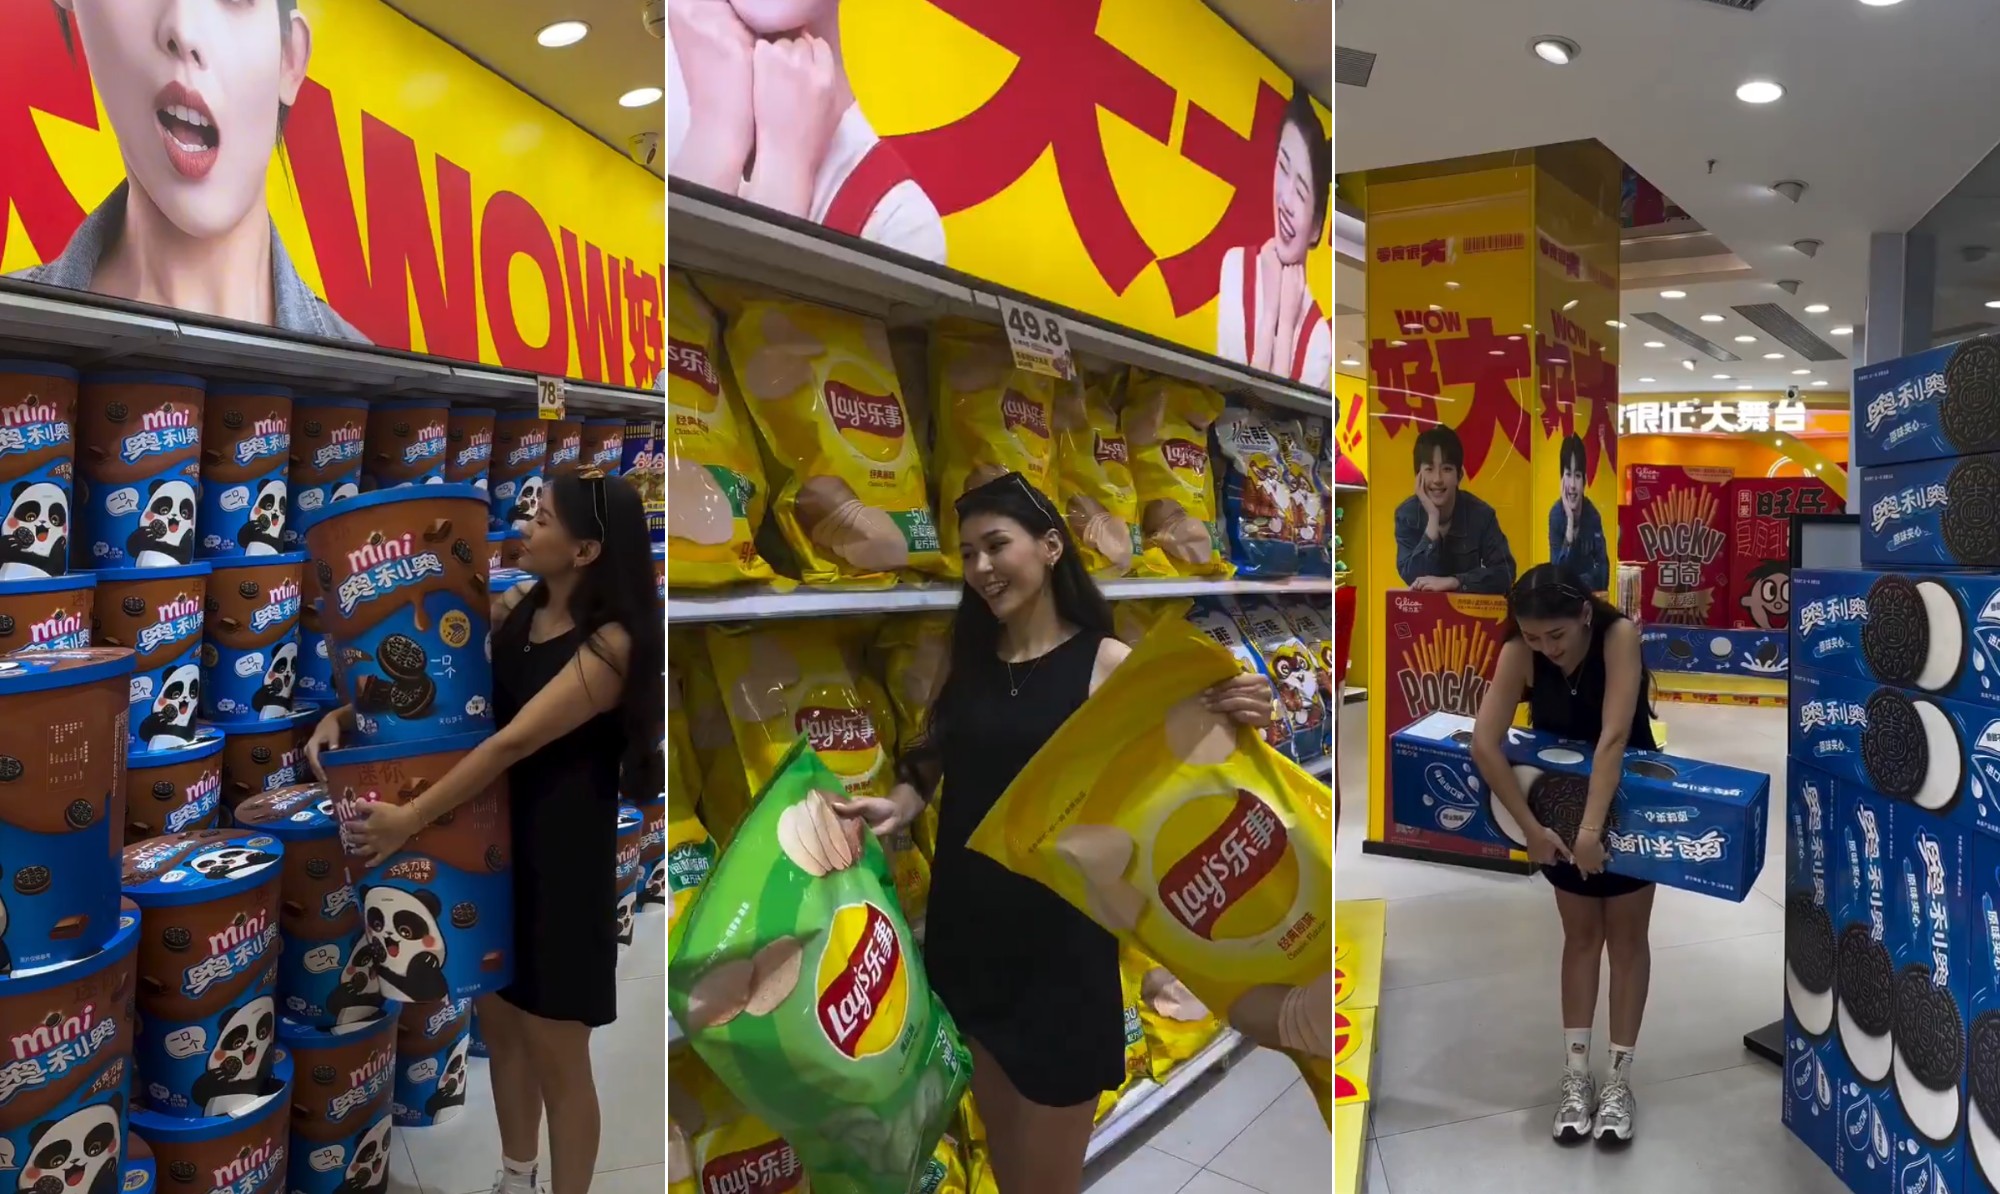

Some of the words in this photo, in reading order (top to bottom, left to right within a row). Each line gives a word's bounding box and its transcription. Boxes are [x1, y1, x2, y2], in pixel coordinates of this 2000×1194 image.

[283, 76, 627, 386] WOW
[623, 255, 664, 389] 好
[1008, 307, 1063, 347] 49.8
[1394, 309, 1462, 336] WOW
[1551, 309, 1587, 349] WOW
[539, 381, 556, 405] 78
[830, 390, 868, 427] Lay's
[868, 403, 902, 428] 乐事
[1369, 317, 1532, 482] 好大
[1866, 372, 1949, 433] 奥利奥
[2, 402, 57, 426] mini
[142, 408, 189, 430] mini
[1888, 420, 1921, 444] 原味夹心
[1756, 488, 1828, 520] 旺仔
[1871, 484, 1949, 533] 奥利奥
[348, 532, 412, 572] mini
[1893, 526, 1923, 547] 原味夹心
[339, 552, 443, 612] 奥利奥
[1658, 561, 1700, 587] 百奇
[31, 612, 82, 643] mini
[158, 596, 200, 623] mini
[1799, 597, 1869, 636] 奥利奥
[430, 655, 452, 665] 一口
[1819, 637, 1846, 653] 原味夹心
[433, 666, 456, 679] 一个
[1799, 699, 1869, 734] 奥利奥
[1819, 739, 1846, 754] 原味夹心
[1645, 810, 1690, 823] 原味夹心
[1608, 830, 1726, 862] 奥利奥
[1802, 780, 1825, 907] 奥利奥
[390, 860, 432, 876] 巧克力味
[1168, 852, 1231, 927] Lay's
[1219, 802, 1276, 877] 乐事
[1857, 803, 1885, 942] 奥利奥
[1907, 873, 1921, 928] 原味夹心
[1917, 833, 1949, 988] 奥利奥
[208, 908, 267, 955] mini
[828, 963, 873, 1043] Lay's
[863, 914, 895, 987] 乐事
[11, 1003, 95, 1060] mini
[213, 1137, 272, 1188] mini
